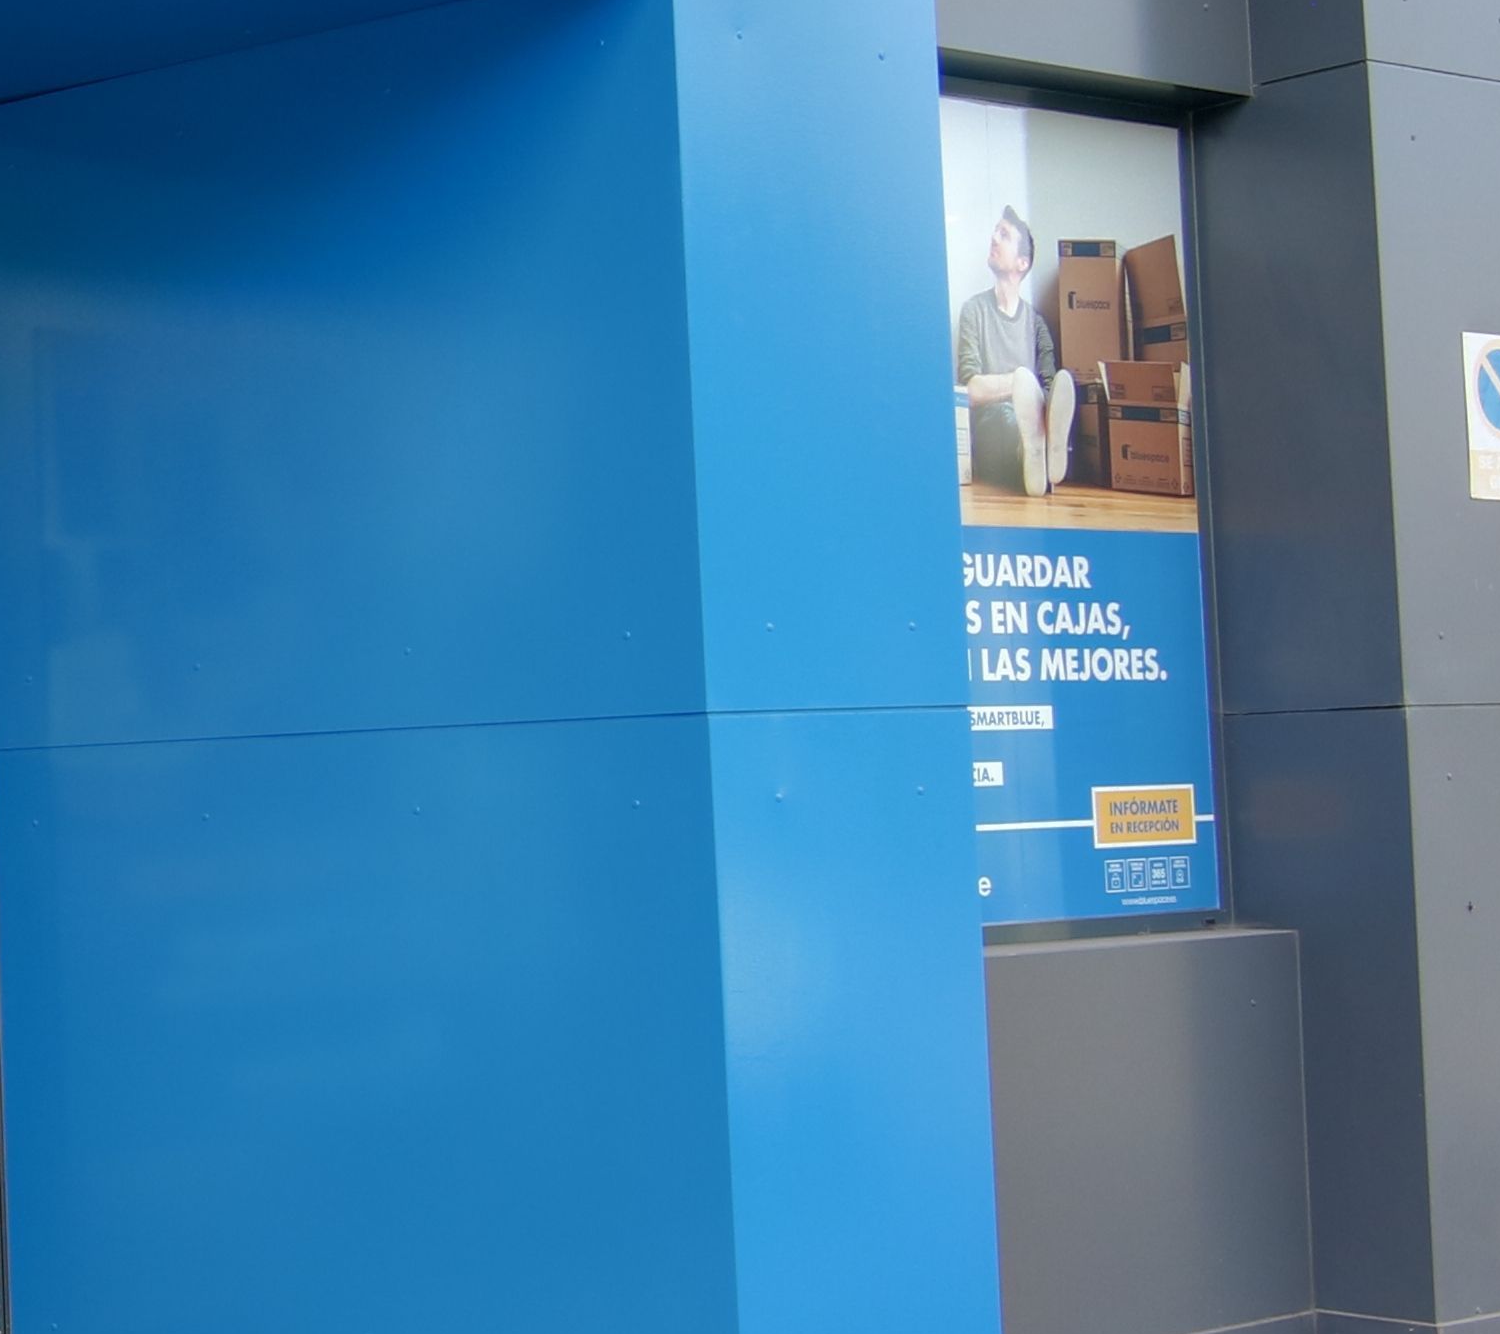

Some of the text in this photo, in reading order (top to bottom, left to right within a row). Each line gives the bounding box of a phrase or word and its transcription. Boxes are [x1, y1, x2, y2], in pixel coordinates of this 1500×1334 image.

[962, 552, 1092, 588] GUARDAR
[991, 601, 1029, 635] EN
[1036, 601, 1131, 640] CAJAS,
[981, 648, 1032, 682] LAS
[1040, 648, 1168, 682] MEJORES.
[970, 710, 1045, 728] SMARTBLUE,
[1109, 797, 1178, 816] INFÓRMATE
[1110, 817, 1179, 834] EN RECEPCIÓN
